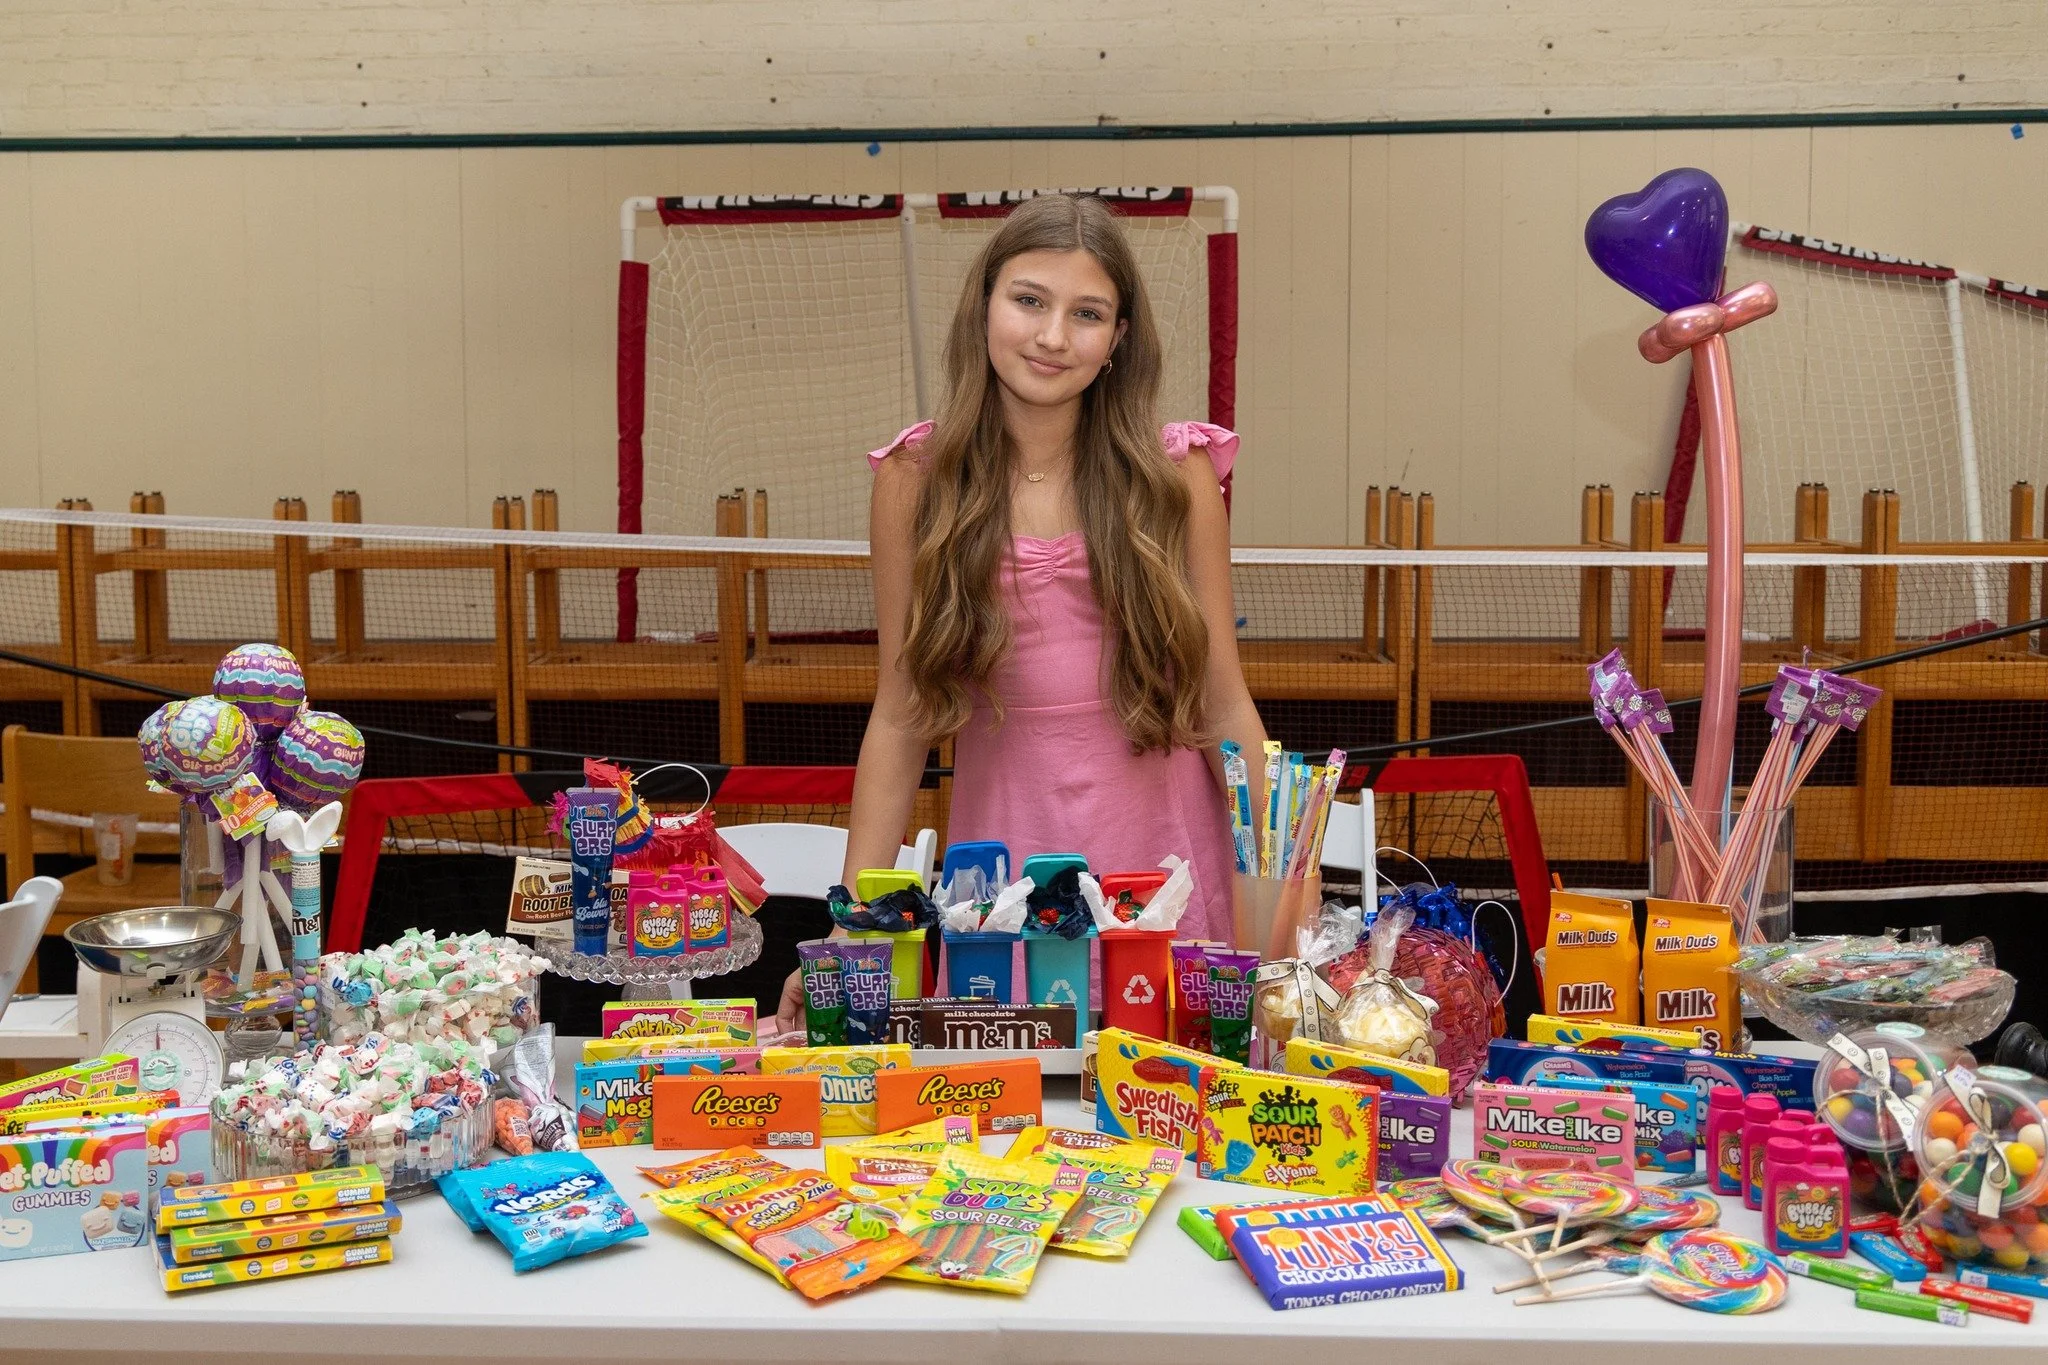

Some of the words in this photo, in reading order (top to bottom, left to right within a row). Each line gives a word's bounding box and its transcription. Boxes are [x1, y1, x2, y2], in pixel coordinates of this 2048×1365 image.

[219, 814, 240, 835] 10
[522, 898, 556, 912] ROOT
[560, 897, 573, 909] BE
[642, 917, 678, 934] BUBBLE
[693, 918, 713, 930] JUG
[649, 928, 670, 939] JUG
[1557, 931, 1584, 946] Milk
[1587, 930, 1617, 944] Duds
[1655, 937, 1682, 952] Milk
[1685, 934, 1717, 949] Duds
[804, 972, 842, 993] SLUR
[845, 972, 891, 994] SLURP
[1180, 972, 1208, 993] SLU
[1558, 982, 1614, 1014] Milk
[1657, 988, 1716, 1020] Milk
[697, 1026, 719, 1034] FRUITY
[944, 1021, 1051, 1049] m&m's
[825, 1065, 841, 1073] CANDY
[1363, 1053, 1402, 1066] Swedish
[1404, 1062, 1427, 1071] Fish
[1543, 1061, 1572, 1069] CHARMS
[1605, 1063, 1646, 1071] Watermelon
[1743, 1067, 1785, 1075] Watermelon
[595, 1079, 653, 1099] Mike
[918, 1075, 1005, 1104] Reese's
[1207, 1080, 1240, 1095] SUPER
[692, 1085, 782, 1114] Reese's
[1115, 1080, 1199, 1134] Swedish
[1209, 1092, 1230, 1104] SOUR
[606, 1098, 652, 1119] Meg
[1252, 1103, 1316, 1126] SOUR
[948, 1127, 966, 1136] NEW
[1134, 1108, 1184, 1150] Fish
[1389, 1117, 1436, 1144] Ike
[1487, 1107, 1565, 1136] Mike
[1564, 1116, 1576, 1140] and
[1575, 1117, 1622, 1144] Ike
[1251, 1124, 1321, 1146] PATCH
[1280, 1143, 1307, 1156] Kids
[1511, 1139, 1538, 1150] SOUR
[1539, 1140, 1596, 1154] Watermelon
[1151, 1164, 1176, 1172] LOOK!
[1155, 1157, 1174, 1165] NEW
[1201, 1162, 1211, 1170] 110
[0, 1157, 111, 1190] et-Puffed
[1056, 1178, 1081, 1187] LOOK!
[1086, 1172, 1147, 1188] DES
[337, 1187, 371, 1198] GUMMY
[723, 1177, 819, 1215] HARIBO
[961, 1178, 1050, 1200] SOUR
[1086, 1186, 1139, 1203] BELTS
[13, 1189, 92, 1212] GUMMIES
[943, 1192, 1052, 1212] DUDES
[177, 1207, 207, 1218] Frankford
[752, 1203, 781, 1222] SOUR
[932, 1210, 983, 1223] SOUR
[986, 1213, 1041, 1232] BELTS
[1786, 1202, 1834, 1222] BUBBLE
[1797, 1214, 1823, 1228] JUG
[356, 1221, 389, 1232] GUMMY
[345, 1246, 378, 1257] GUMMY
[1339, 1283, 1444, 1304] CHOCOLONELY
